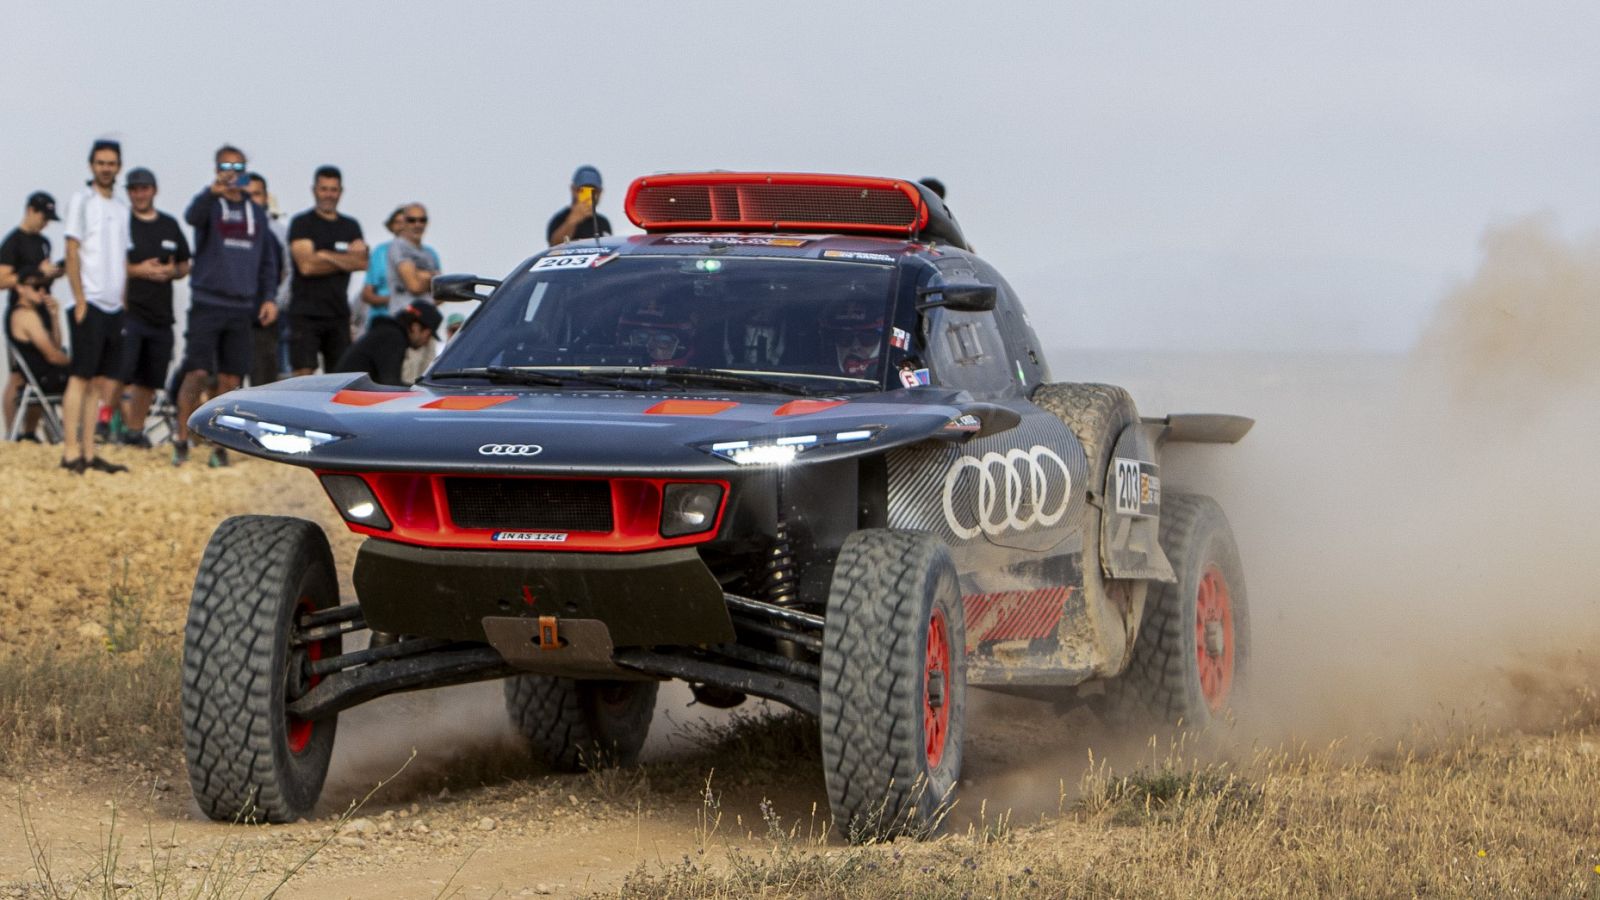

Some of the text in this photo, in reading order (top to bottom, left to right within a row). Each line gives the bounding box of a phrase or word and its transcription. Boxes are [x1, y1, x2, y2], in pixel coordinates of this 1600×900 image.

[540, 257, 588, 267] 203
[1118, 462, 1139, 511] 203
[534, 533, 564, 541] 124E
